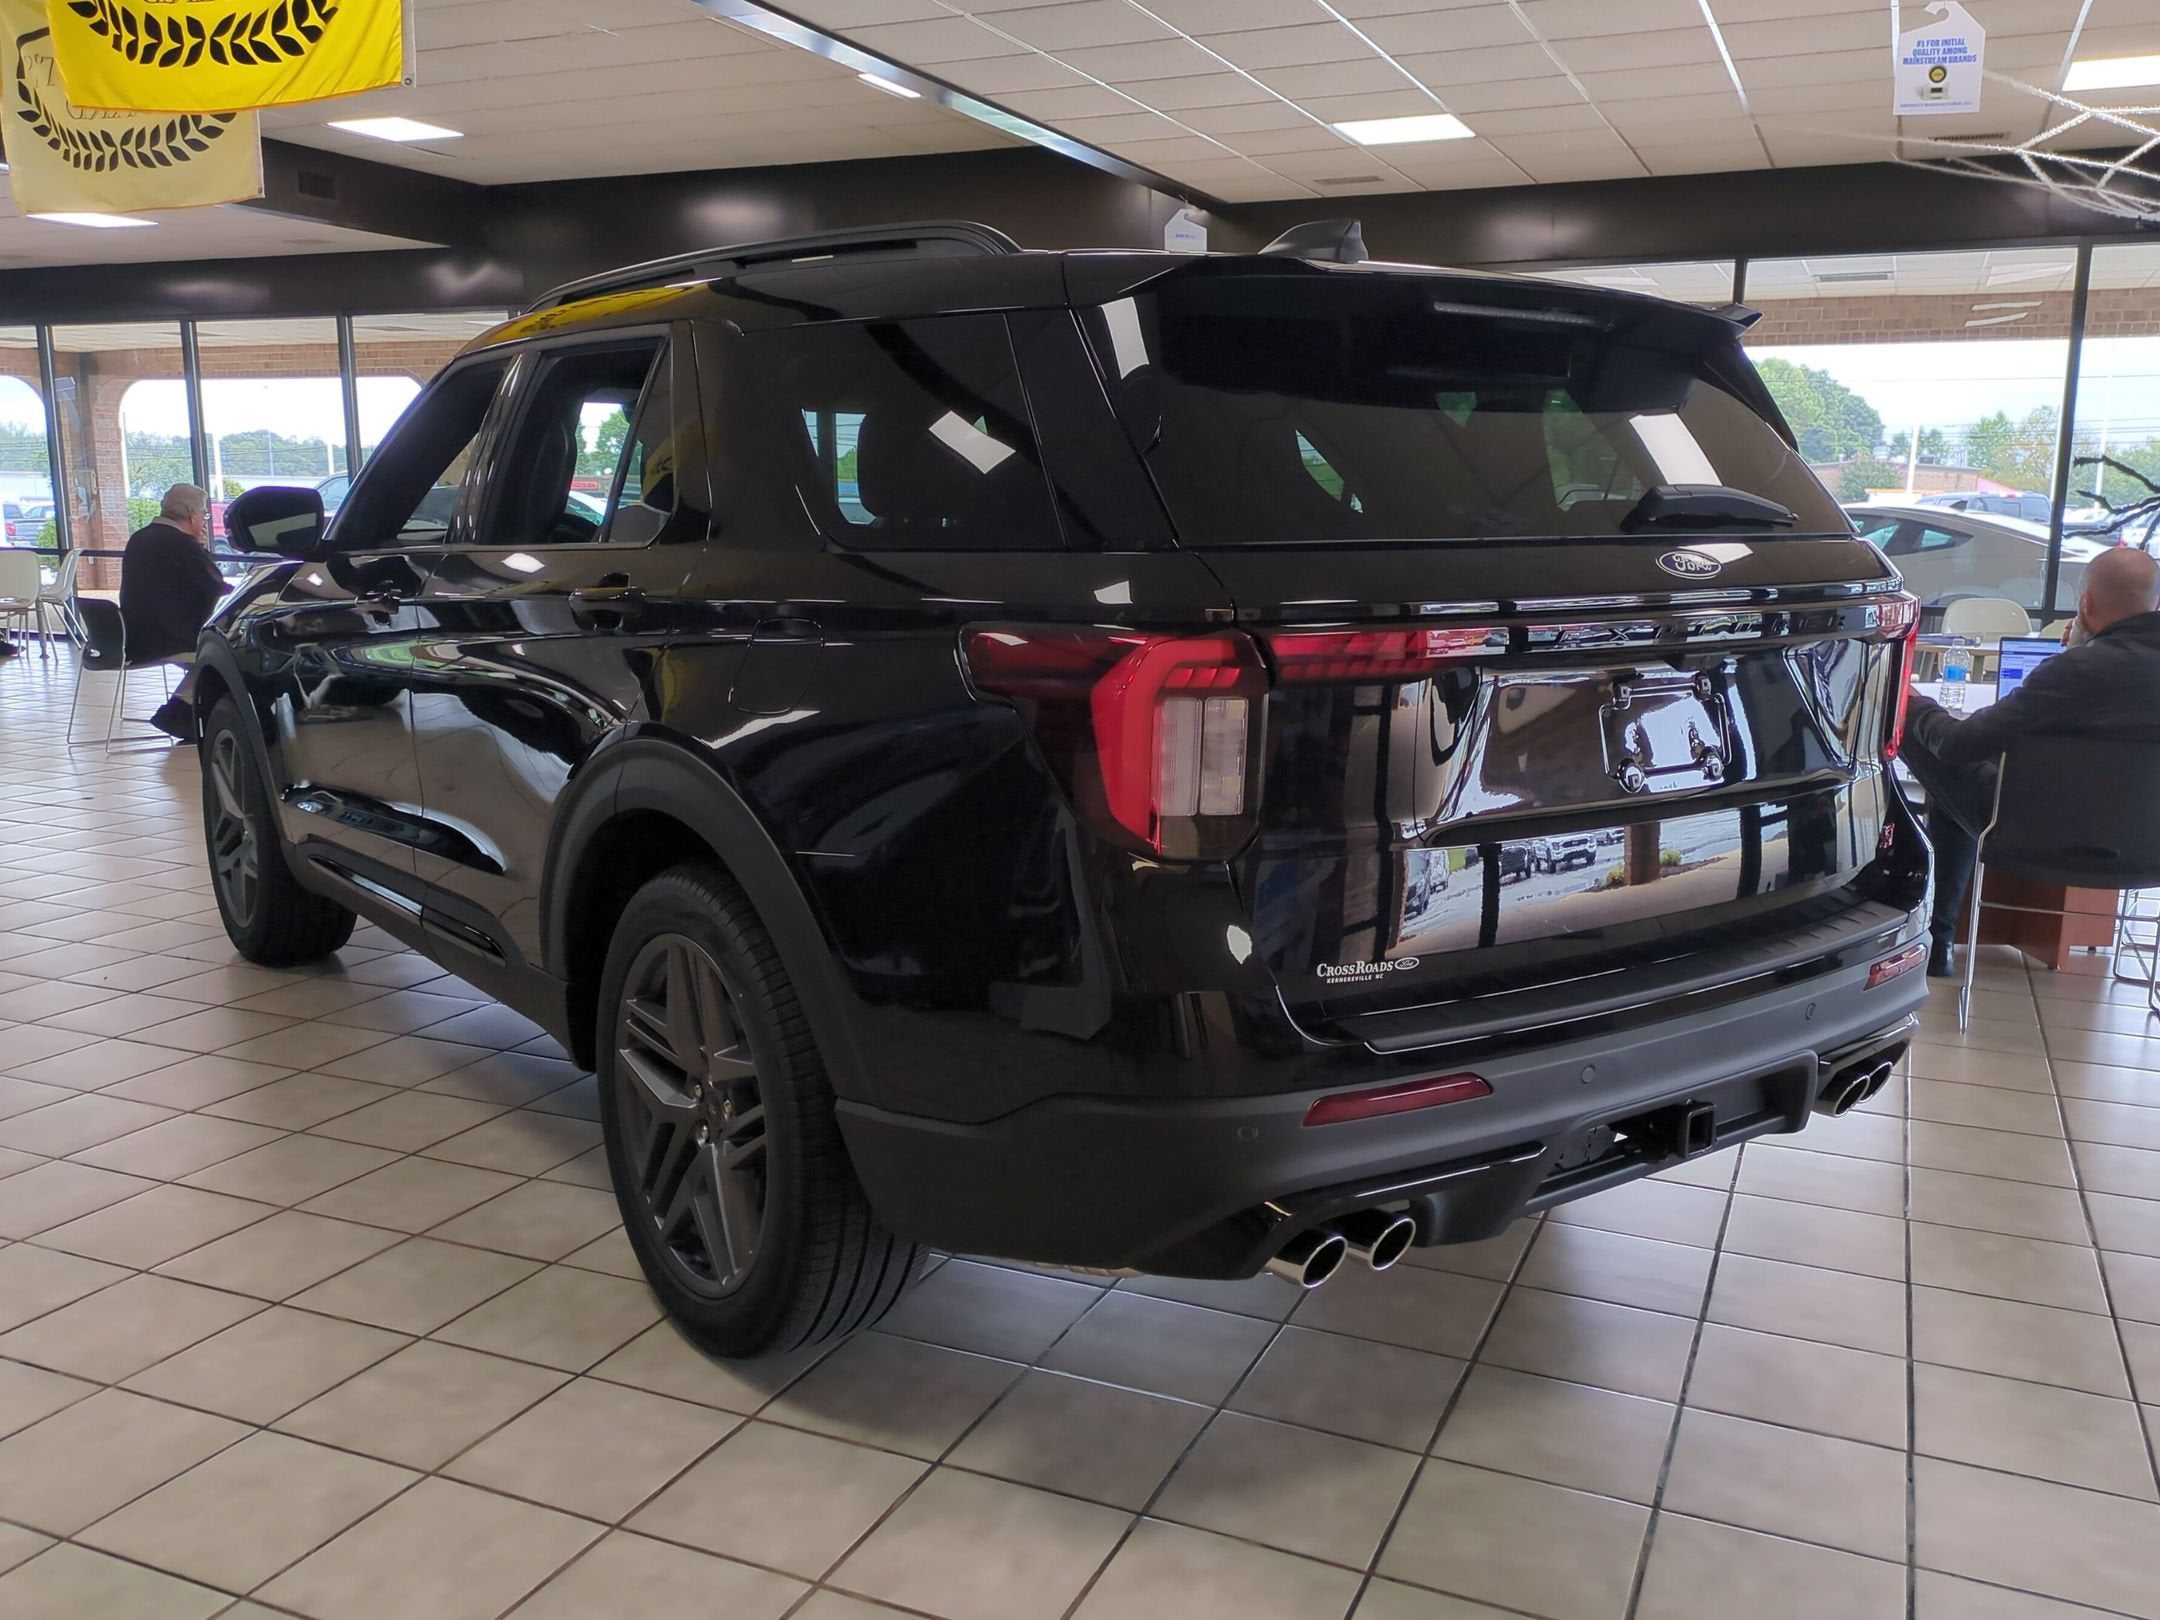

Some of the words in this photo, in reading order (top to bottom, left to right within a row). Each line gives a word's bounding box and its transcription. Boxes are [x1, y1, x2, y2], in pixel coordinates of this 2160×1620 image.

[1926, 39, 1940, 47] FOR
[1941, 38, 1965, 46] INITIAL
[1912, 47, 1941, 57] QUALITY
[1942, 46, 1968, 55] AMONG
[1903, 56, 1948, 65] MAINSTREAM
[1948, 54, 1977, 64] BRANDS
